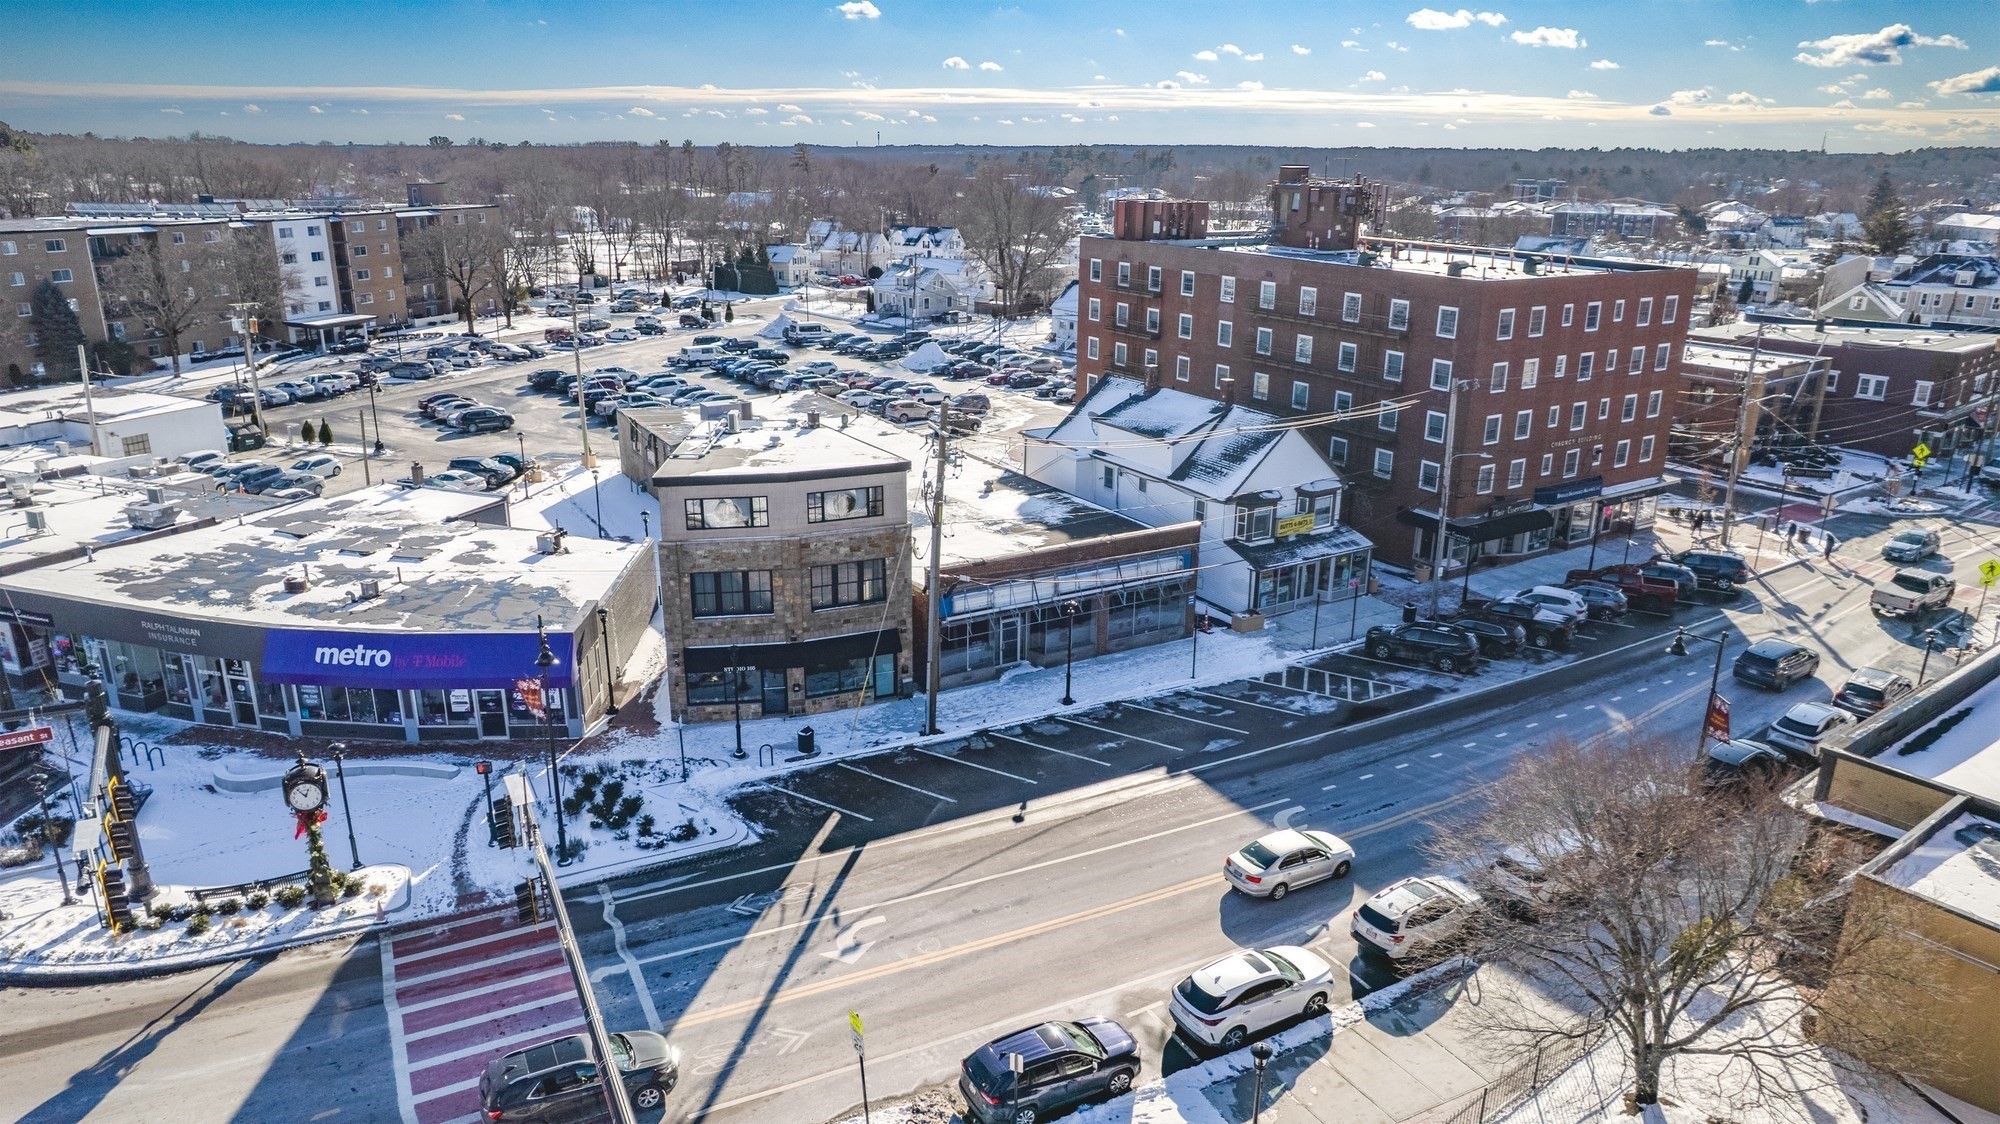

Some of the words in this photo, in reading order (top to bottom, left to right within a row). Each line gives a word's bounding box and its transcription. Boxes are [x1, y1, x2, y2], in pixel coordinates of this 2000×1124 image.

[141, 621, 165, 631] RALPH
[165, 625, 201, 636] TALANIAN
[148, 632, 197, 646] INSURANCE
[314, 644, 391, 667] metro
[233, 659, 239, 668] 3
